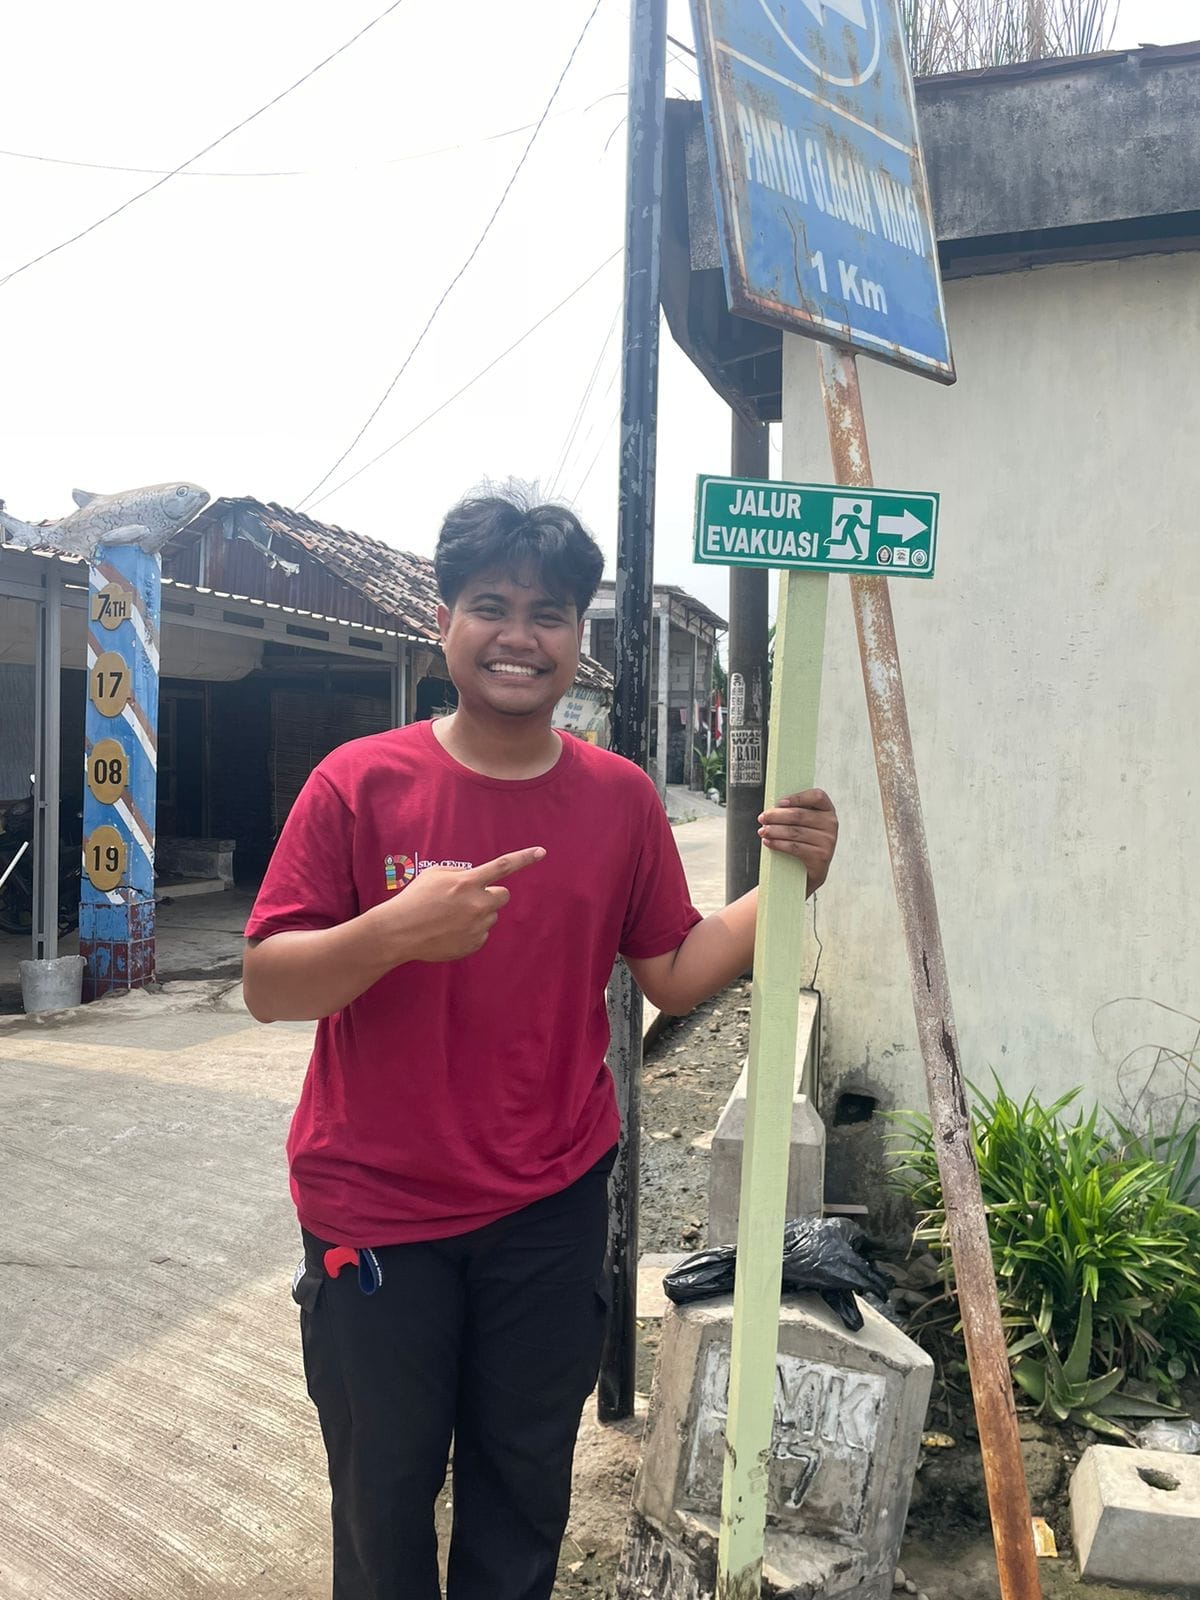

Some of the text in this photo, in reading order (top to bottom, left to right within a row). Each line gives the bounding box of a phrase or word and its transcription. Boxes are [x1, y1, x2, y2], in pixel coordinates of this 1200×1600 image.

[736, 101, 926, 258] PANTAI GLAGAH WANGI
[811, 250, 888, 315] 1 Km
[728, 489, 802, 520] JALUR
[706, 524, 819, 559] EVAKUASI
[97, 593, 127, 619] 74TH
[96, 671, 123, 698] 17
[94, 758, 122, 785] 08
[92, 845, 119, 872] 19
